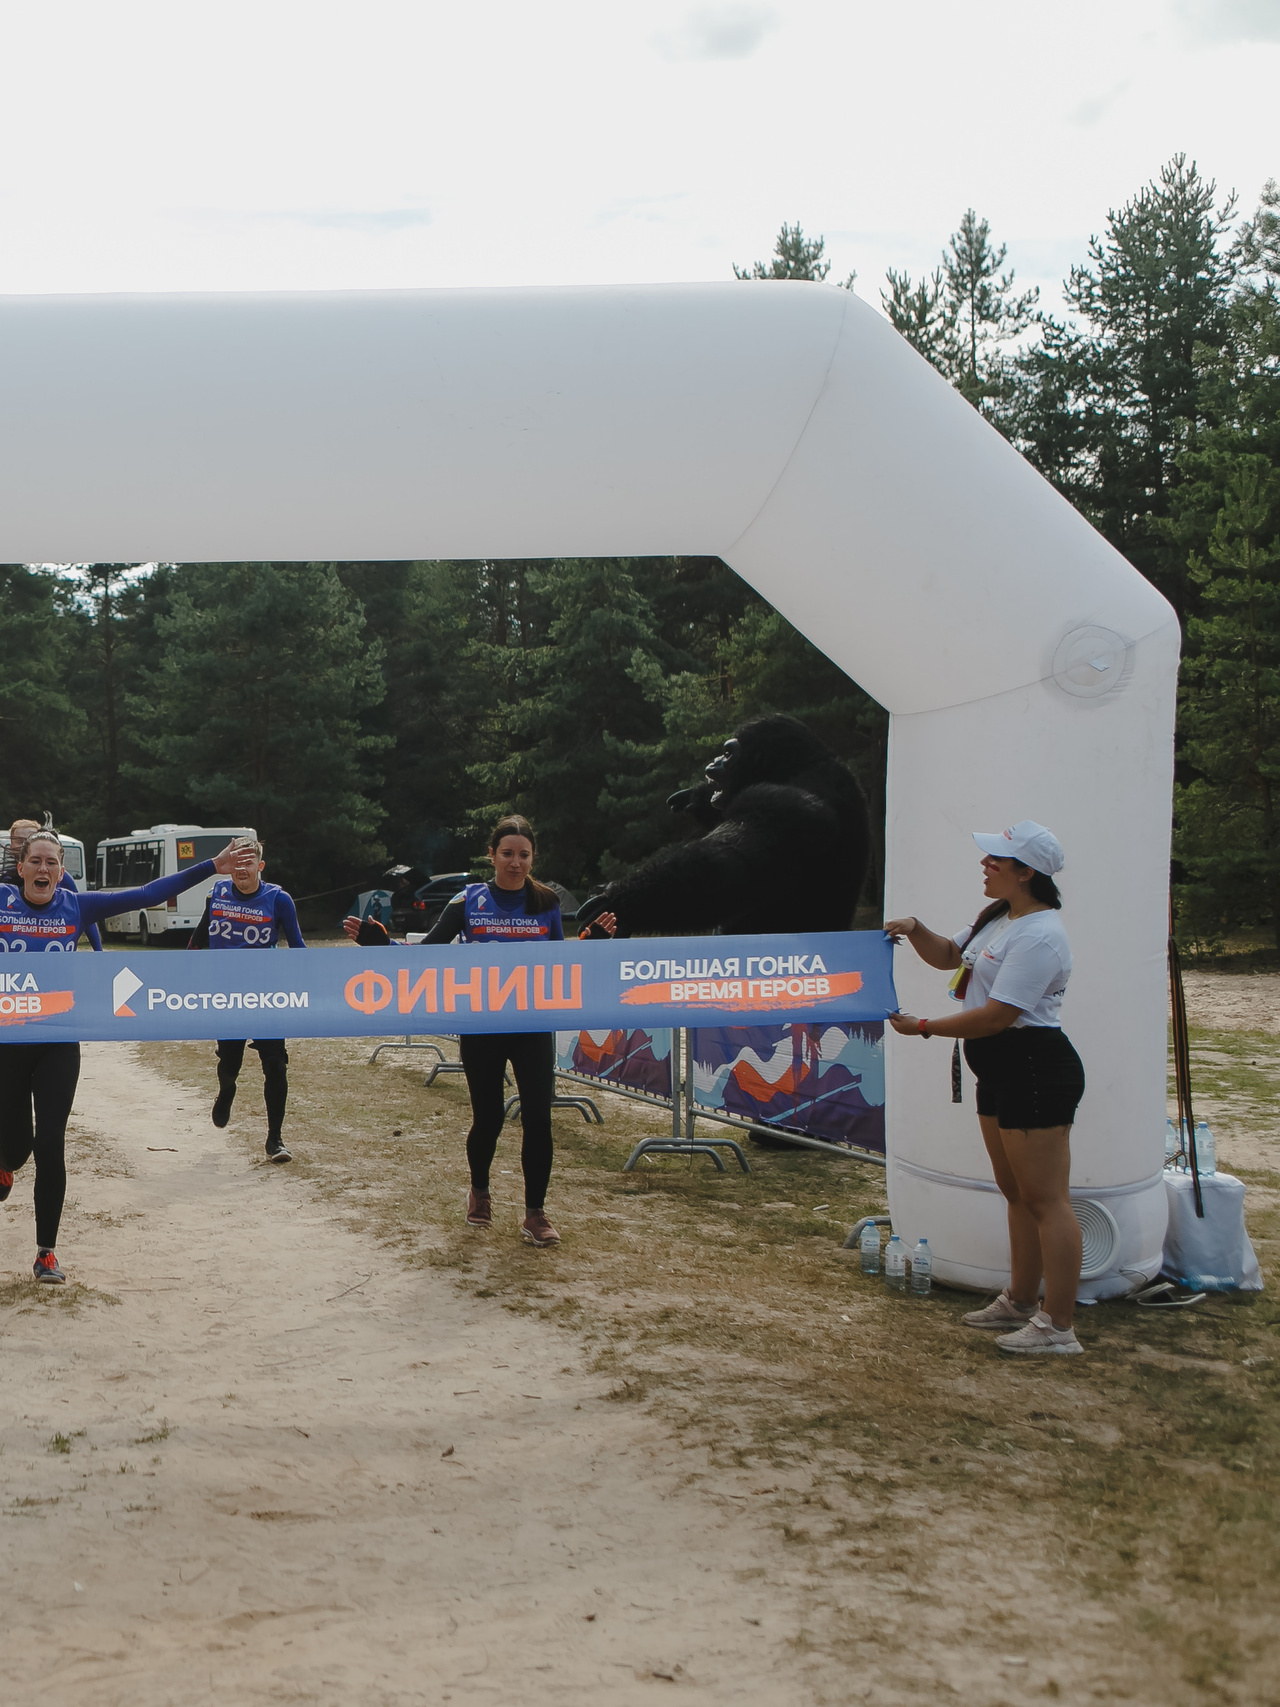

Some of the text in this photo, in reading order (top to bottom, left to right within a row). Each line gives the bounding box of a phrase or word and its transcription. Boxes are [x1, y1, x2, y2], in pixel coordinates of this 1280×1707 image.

[211, 902, 263, 916] БОЛЬШАЯ ГОНКА
[222, 910, 263, 922] ВРЕМЯ ГЕРОЕВ
[38, 917, 66, 926] ГОНКА
[469, 917, 539, 926] БОЛЬШАЯ ГОНКА
[12, 925, 67, 934] ВРЕМЯ ГЕРОЕВ
[208, 919, 272, 945] 02-03
[486, 926, 540, 934] ВРЕМЯ ГЕРОЕВ
[619, 954, 828, 981] БОЛЬШАЯ ГОНКА
[343, 963, 583, 1015] ФИНИШ
[670, 978, 830, 1001] ВРЕМЯ ГЕРОЕВ
[148, 988, 309, 1011] Ростелеком
